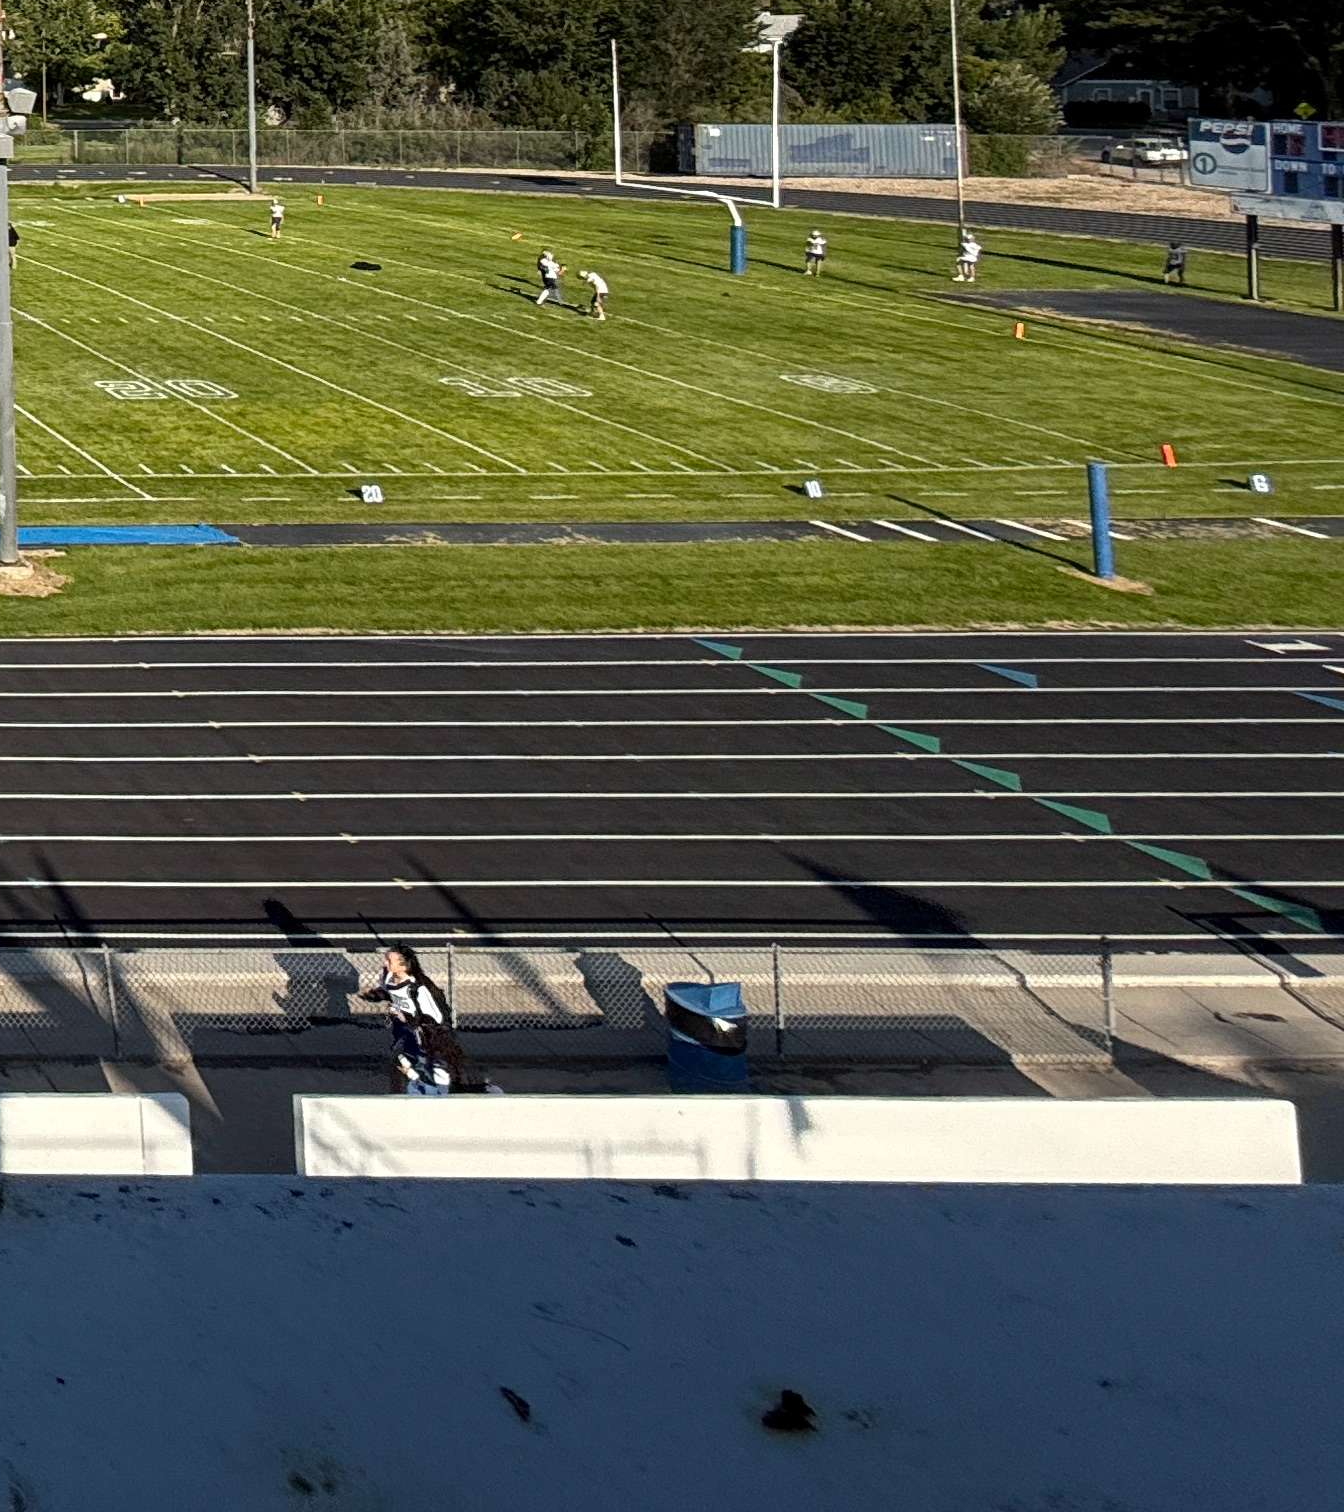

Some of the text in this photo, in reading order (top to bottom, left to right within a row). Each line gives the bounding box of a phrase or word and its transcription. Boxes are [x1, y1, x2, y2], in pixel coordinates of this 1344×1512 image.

[1199, 121, 1254, 136] PEPSI
[1272, 123, 1304, 135] HOME
[1274, 159, 1308, 172] DOWN
[93, 379, 240, 400] 20
[438, 377, 593, 397] 10
[361, 484, 383, 503] 20
[804, 480, 822, 498] 10
